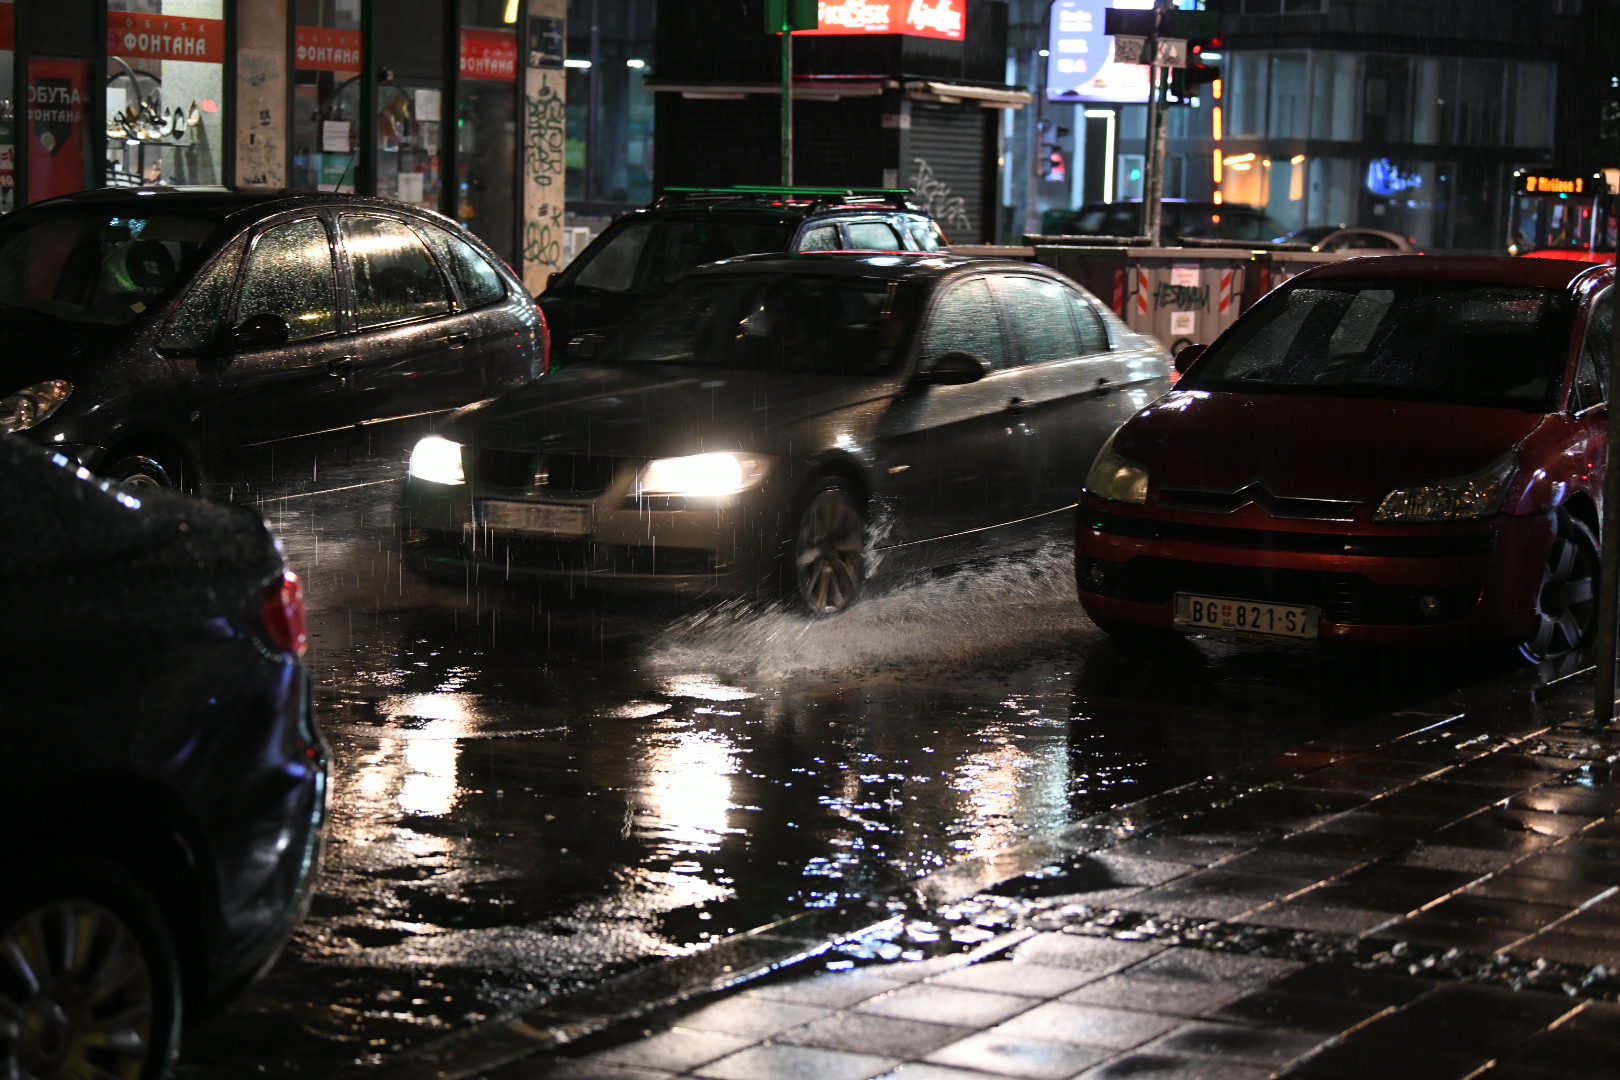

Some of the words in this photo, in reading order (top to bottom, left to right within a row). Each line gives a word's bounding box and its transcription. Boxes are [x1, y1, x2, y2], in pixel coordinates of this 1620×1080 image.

[124, 32, 206, 56] ФОНТАНА
[297, 45, 359, 65] ФОНТАНА
[28, 85, 81, 104] ОБУЋА
[1192, 600, 1218, 624] BG
